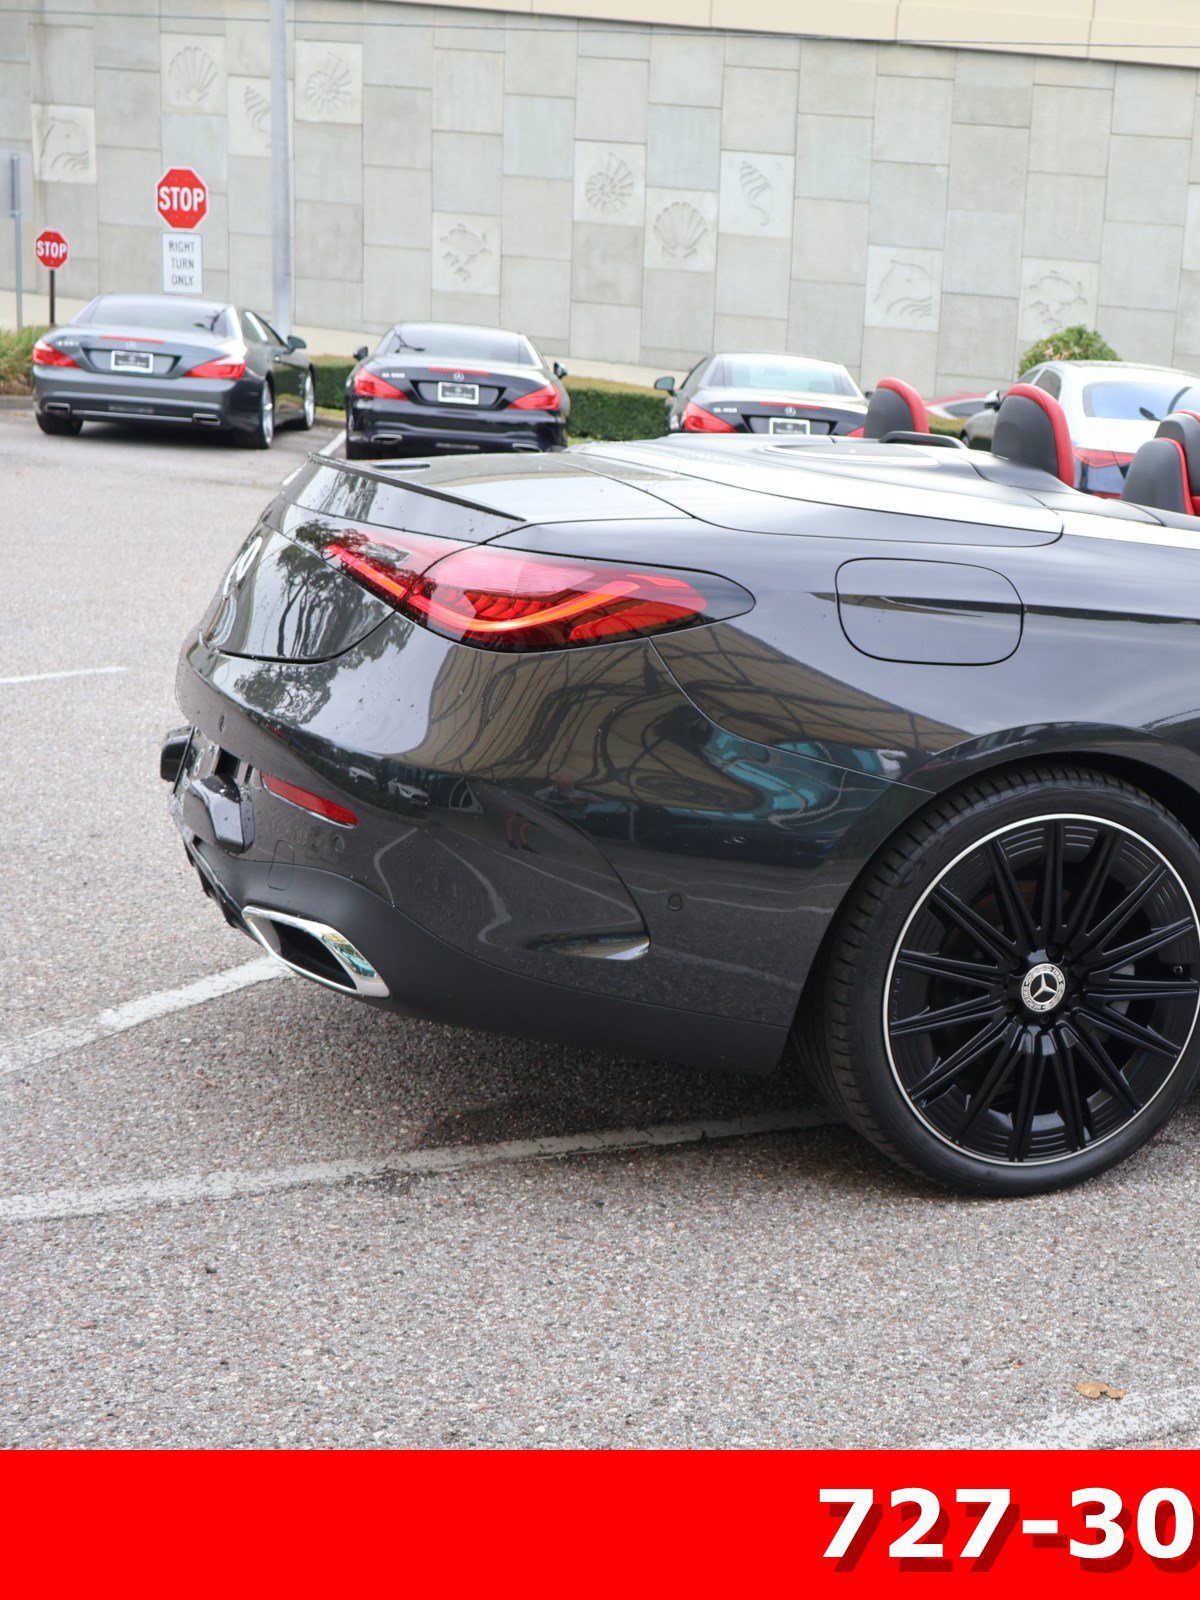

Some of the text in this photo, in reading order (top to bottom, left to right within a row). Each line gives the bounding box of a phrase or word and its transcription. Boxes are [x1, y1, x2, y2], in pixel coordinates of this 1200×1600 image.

[158, 186, 205, 212] STOP
[36, 240, 67, 258] STOP
[168, 241, 194, 253] RIGHT
[171, 258, 194, 270] TURN
[171, 274, 194, 286] ONLY
